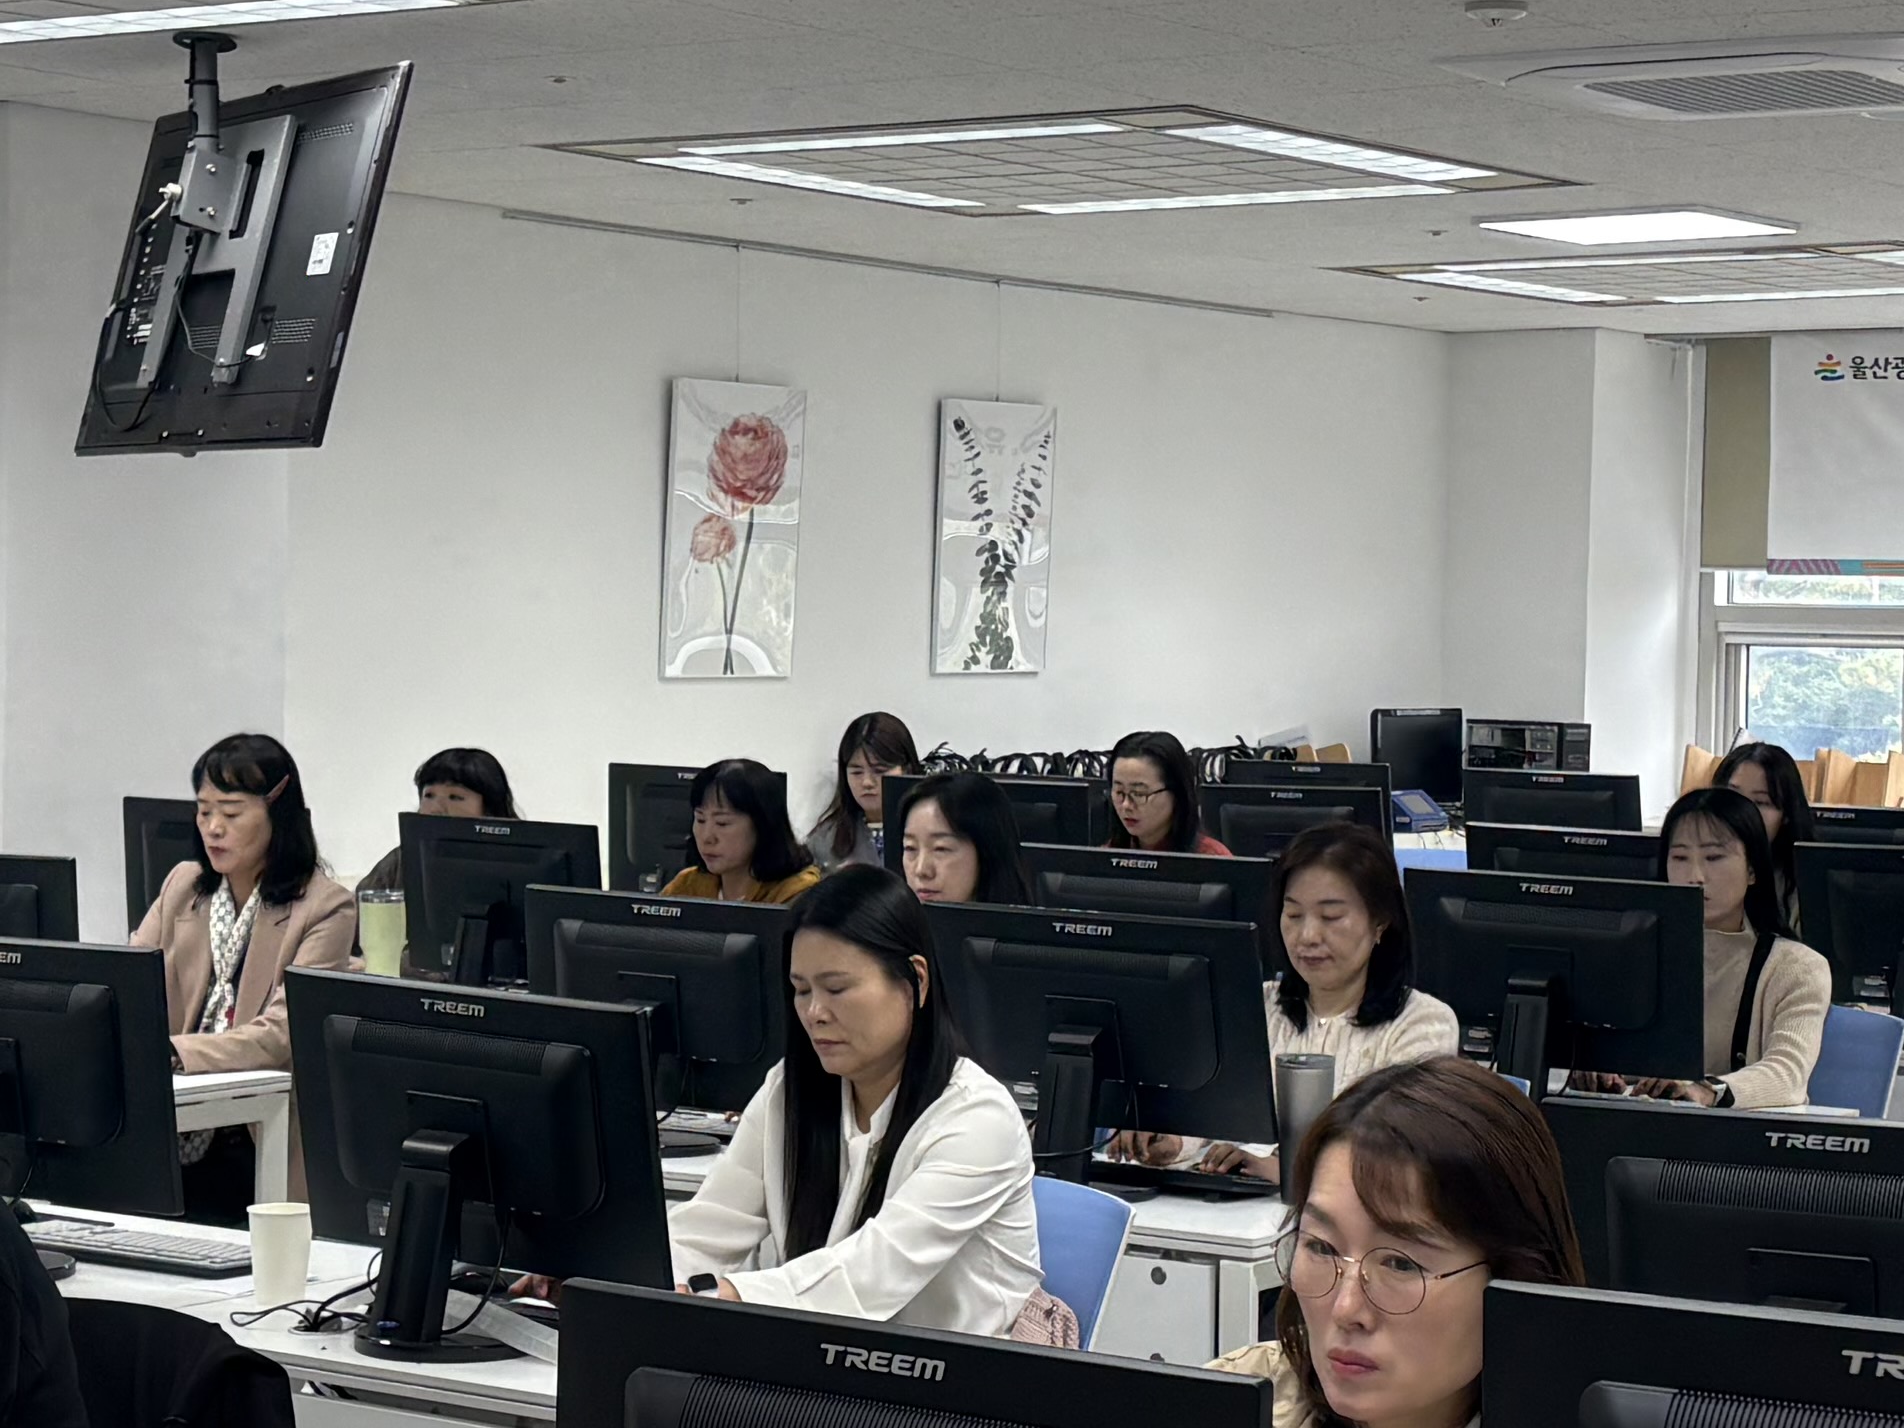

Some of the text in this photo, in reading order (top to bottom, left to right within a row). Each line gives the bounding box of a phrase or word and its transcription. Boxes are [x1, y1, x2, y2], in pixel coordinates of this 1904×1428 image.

[1110, 858, 1158, 869] TREEM
[1520, 883, 1573, 895] TREEM
[631, 904, 681, 917] TREEM
[1053, 923, 1112, 936] TREEM
[421, 999, 484, 1017] TREEM
[1765, 1132, 1870, 1154] TREEM
[820, 1343, 946, 1381] TREEM
